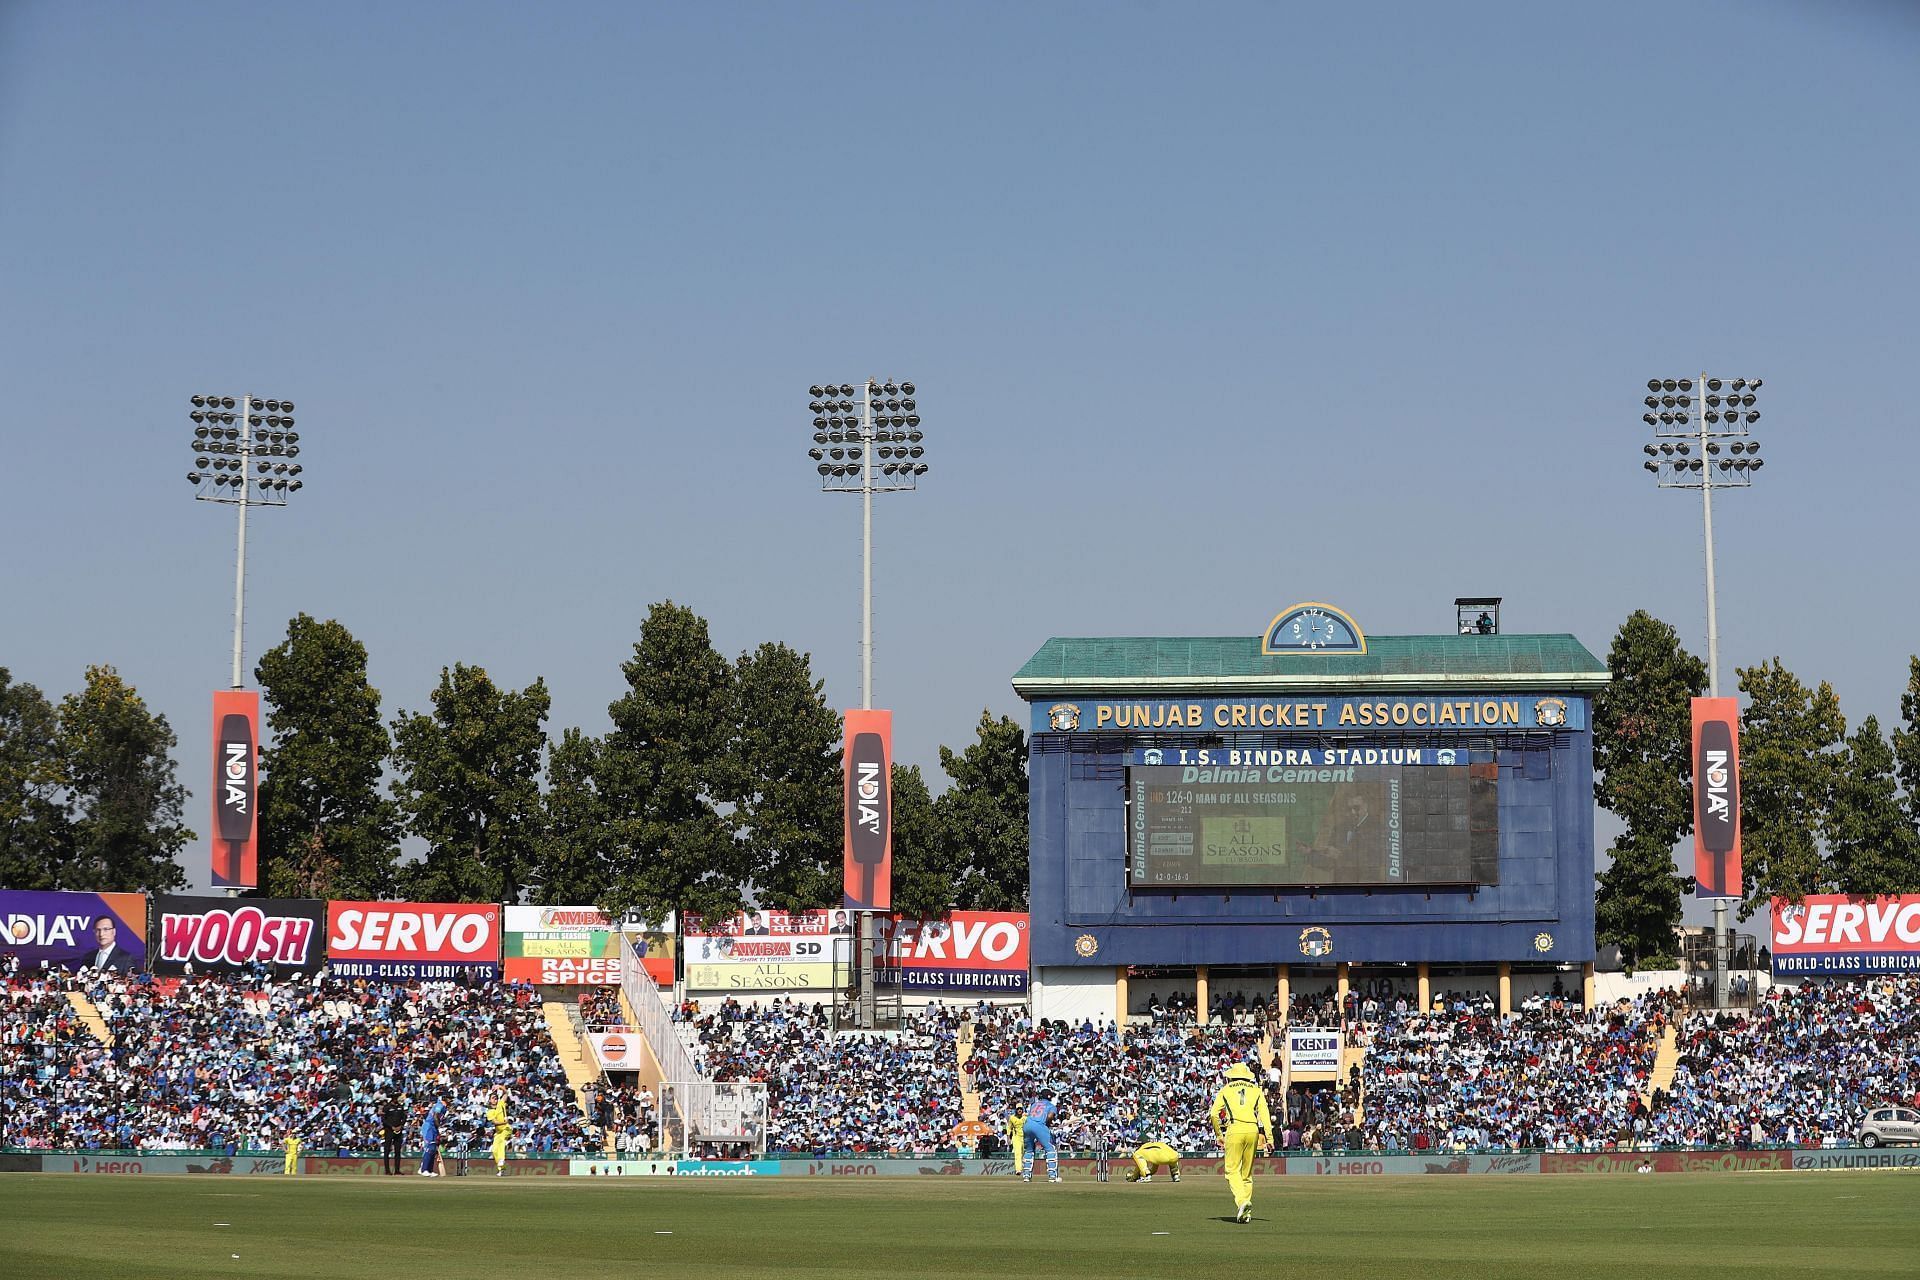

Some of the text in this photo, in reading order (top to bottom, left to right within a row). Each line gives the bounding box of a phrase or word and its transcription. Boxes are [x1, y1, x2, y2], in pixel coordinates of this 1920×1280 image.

[1310, 608, 1318, 616] 12
[1294, 624, 1334, 634] 9 3
[1311, 642, 1317, 650] 6
[1097, 705, 1203, 728] PUNJAB
[1214, 703, 1328, 727] CRICKET
[1339, 702, 1519, 726] ASSOCIATION
[1180, 750, 1421, 765] I.S. BINDRA STADIUM
[1182, 766, 1354, 784] Dalmia Cement
[1166, 790, 1193, 804] 126-0
[1195, 793, 1297, 804] MAN OF ALL SEASONS
[1134, 780, 1145, 879] Dalmia Cement
[1388, 778, 1400, 878] Dalmia Cement
[1230, 835, 1260, 844] ALL
[1206, 844, 1282, 857] SEASONS
[0, 914, 90, 947] NDIA TV
[161, 906, 314, 966] WOOSH
[544, 947, 588, 956] SEASONS
[728, 942, 822, 956] AMBA SD
[333, 963, 416, 977] WORLD-CLASS
[754, 964, 786, 975] ALL
[1778, 956, 1861, 970] WORLD-CLASS
[730, 974, 809, 988] SEASONS
[873, 970, 1021, 987] ORLD-CLASS LUBRICANTS
[1298, 1040, 1331, 1050] KENT
[1238, 1088, 1245, 1106] 1
[1820, 1154, 1896, 1168] HYUNDAI
